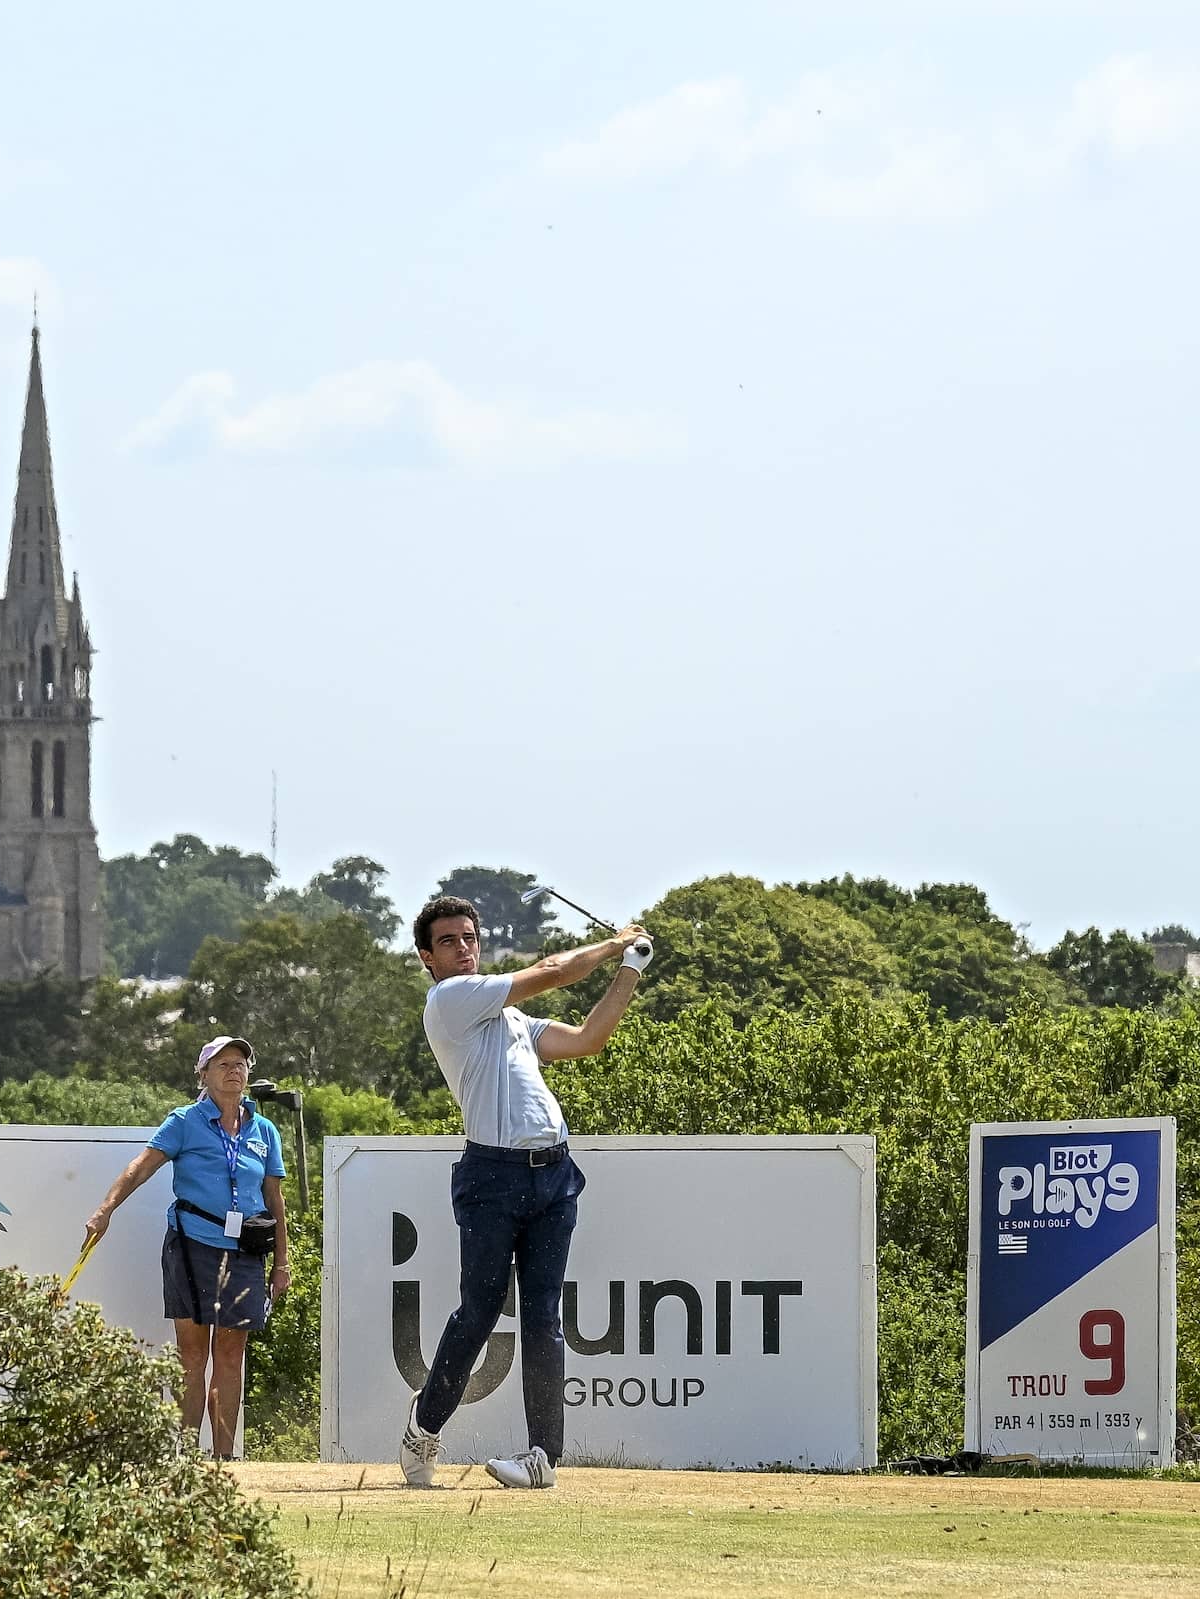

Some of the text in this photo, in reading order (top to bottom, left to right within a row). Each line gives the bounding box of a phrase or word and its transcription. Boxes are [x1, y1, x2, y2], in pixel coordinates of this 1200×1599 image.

[1054, 1150, 1098, 1170] Blot
[999, 1163, 1139, 1228] Play9
[999, 1219, 1071, 1230] LE SON DU GOLF
[1079, 1309, 1125, 1395] 9
[563, 1378, 705, 1407] GROUP
[1007, 1375, 1067, 1396] TROU
[994, 1415, 1022, 1429] PAR
[1026, 1415, 1035, 1429] 4
[1048, 1414, 1075, 1429] 359
[1079, 1418, 1091, 1428] m
[1104, 1413, 1130, 1428] 393
